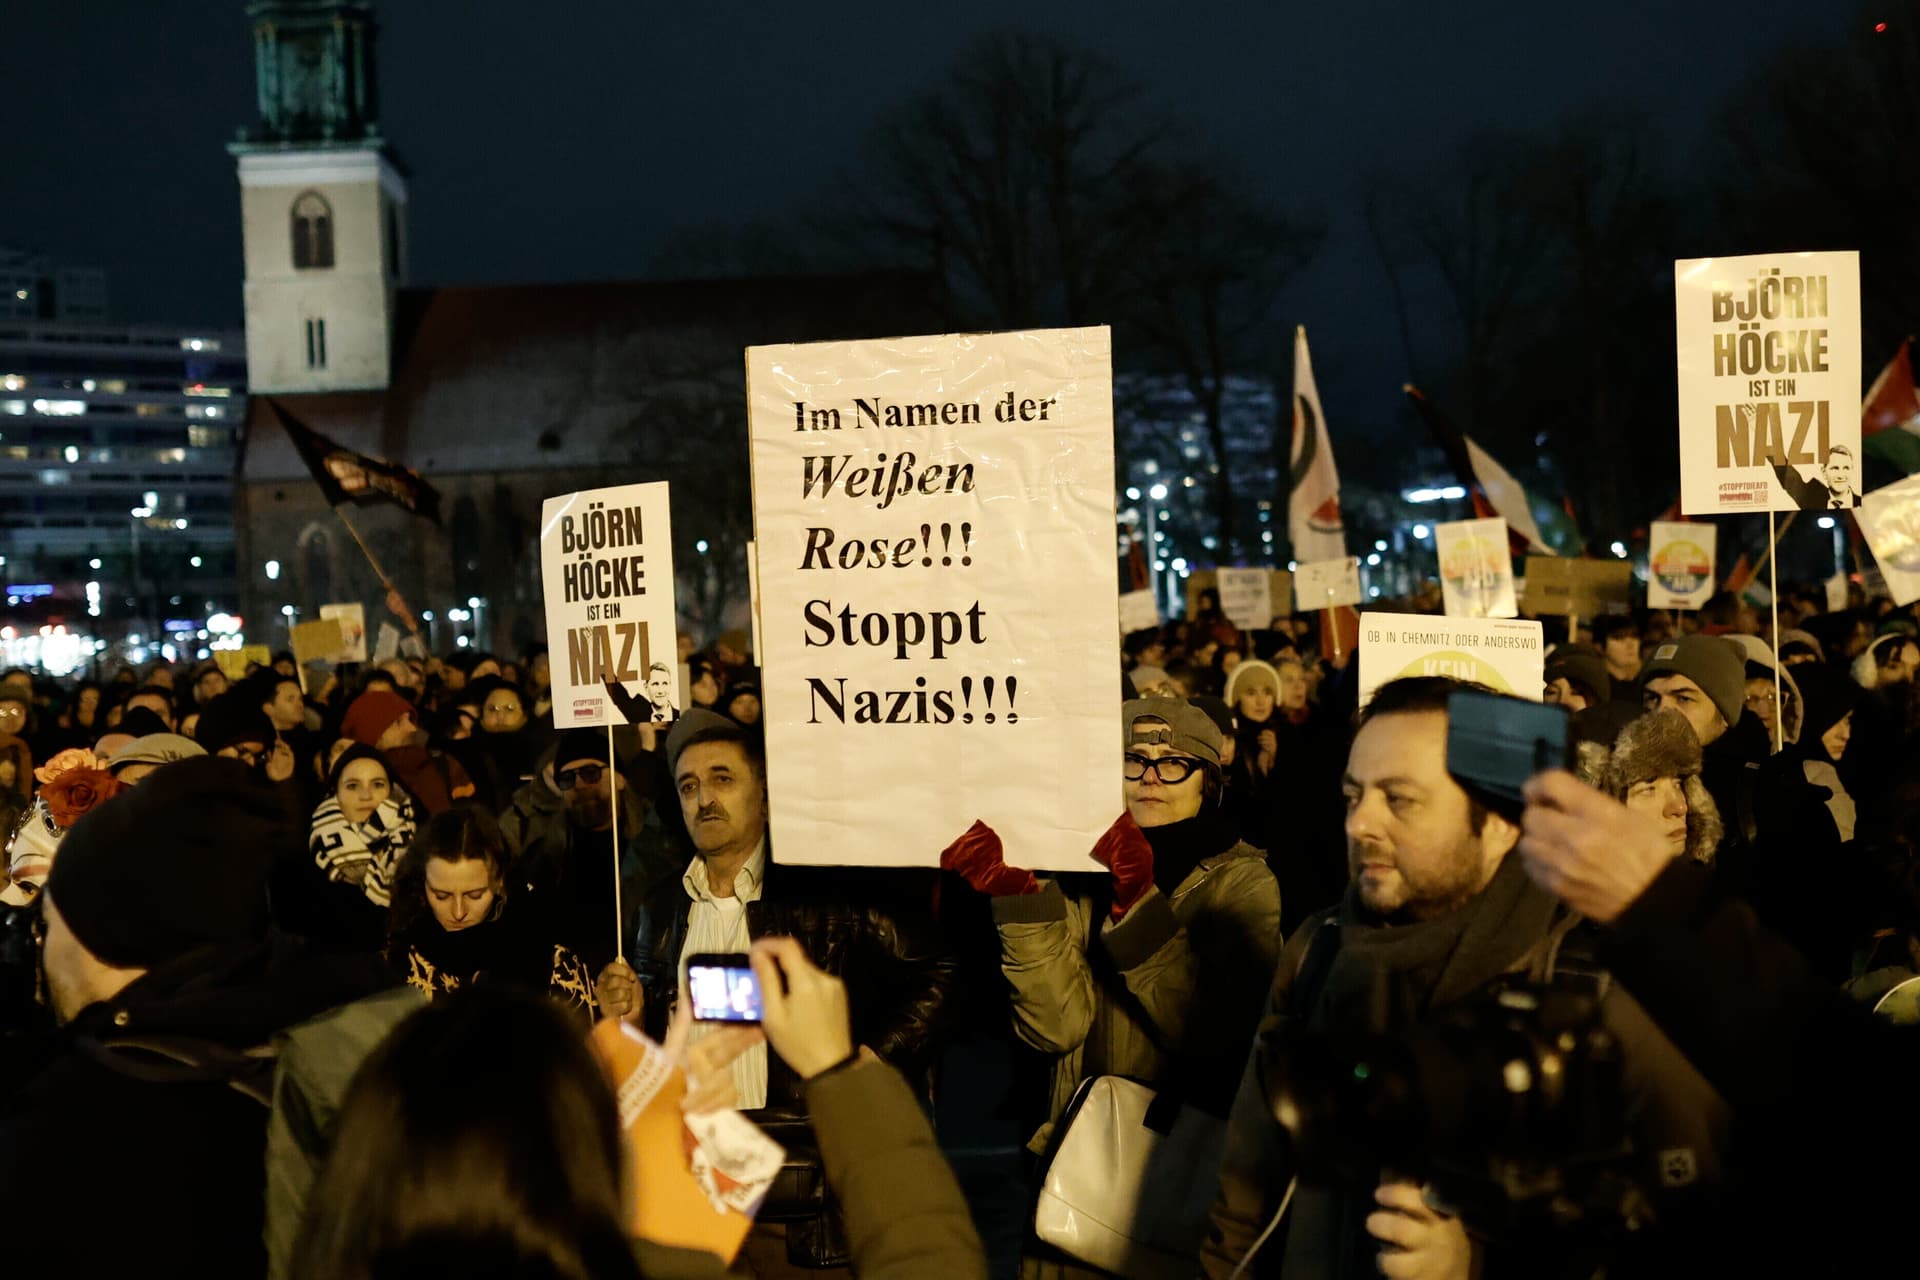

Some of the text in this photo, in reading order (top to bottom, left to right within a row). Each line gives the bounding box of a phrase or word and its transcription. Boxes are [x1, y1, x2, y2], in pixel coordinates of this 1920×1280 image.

[1712, 268, 1828, 323] BJÖRN
[1713, 322, 1829, 376] HÖCKE
[792, 392, 1057, 432] Im Namen der
[1749, 379, 1796, 397] IST EIN
[1715, 400, 1831, 468] NAZI
[802, 451, 976, 510] Weißen
[561, 501, 643, 554] BJÖRN
[797, 522, 973, 571] Rose!!!
[563, 552, 646, 603] HÖCKE
[587, 603, 621, 622] IST EIN
[803, 599, 987, 660] Stoppt
[567, 621, 651, 686] NAZI
[1367, 630, 1537, 650] OB IN CHEMNITZ ODER ANDERSWO
[806, 675, 1019, 724] Nazis!!!
